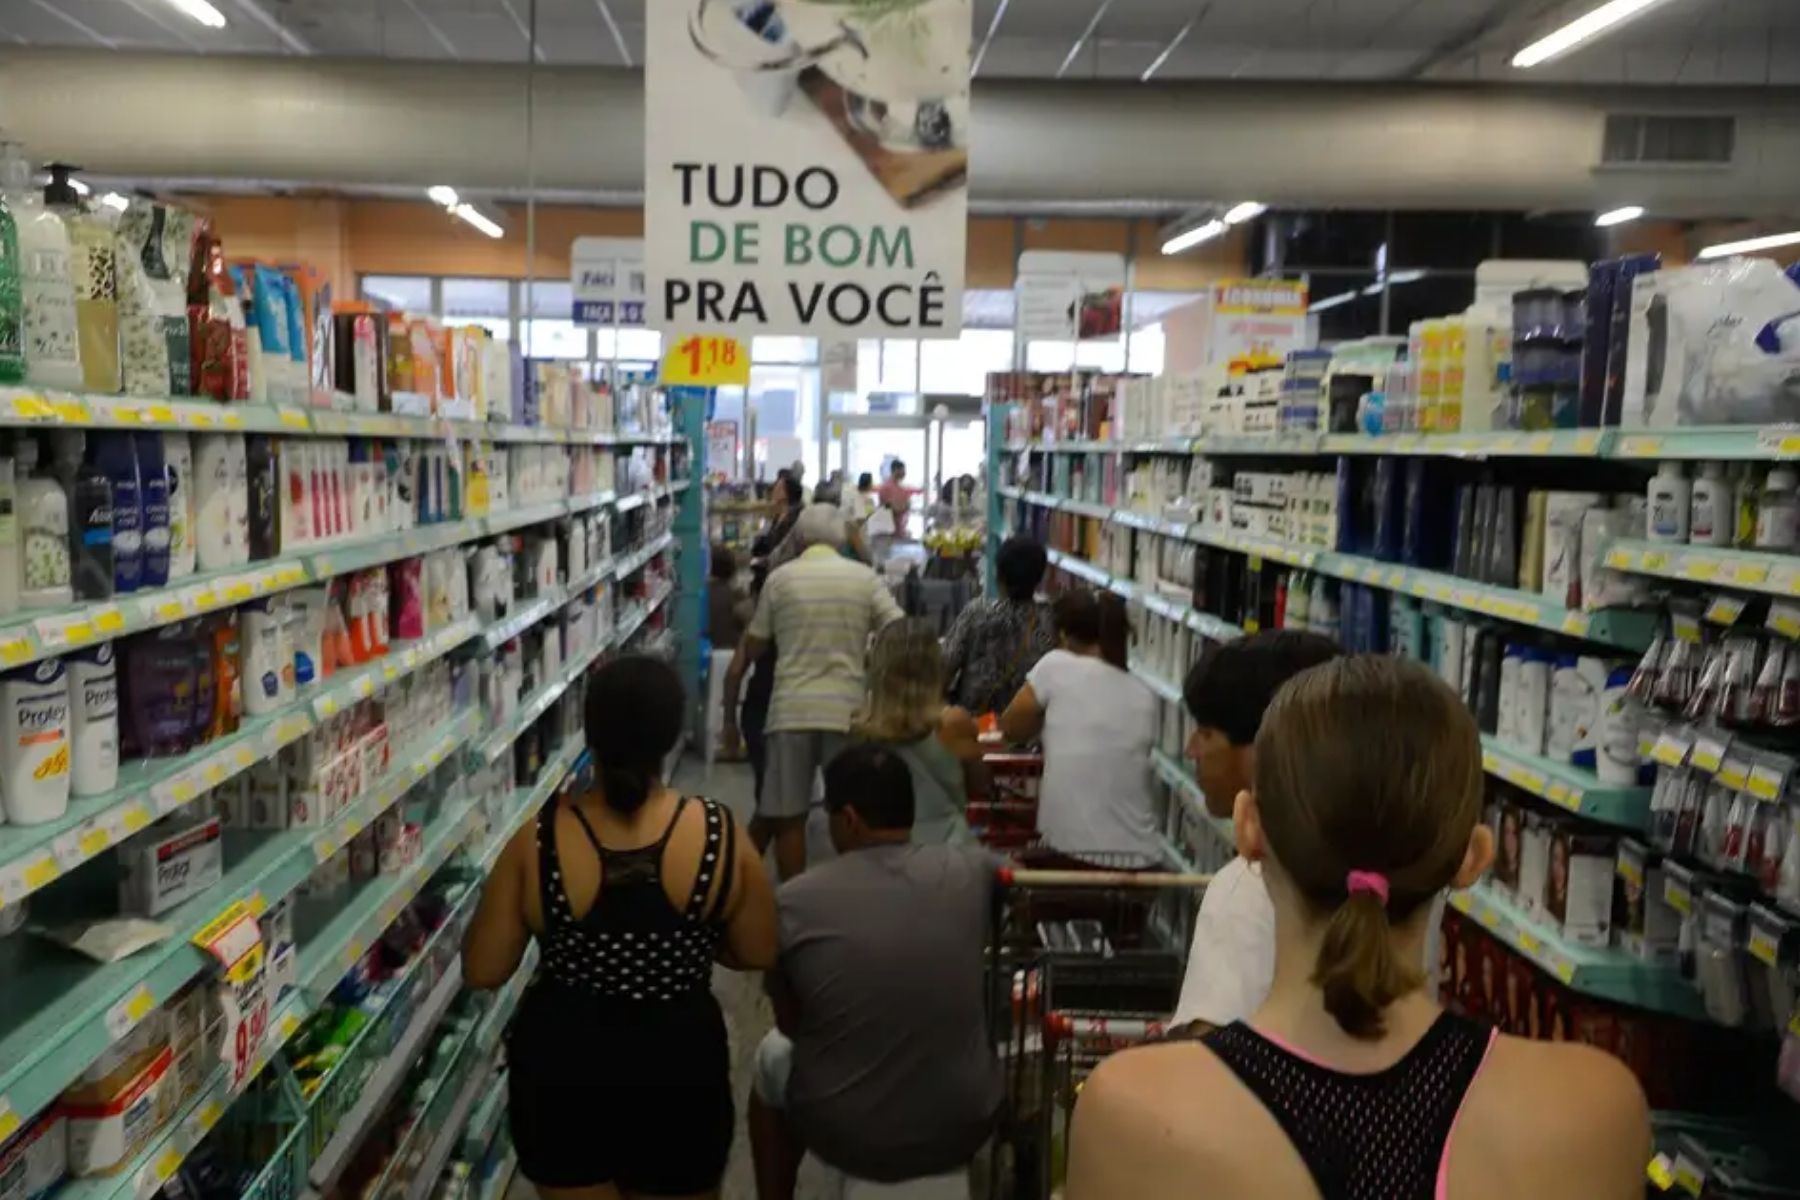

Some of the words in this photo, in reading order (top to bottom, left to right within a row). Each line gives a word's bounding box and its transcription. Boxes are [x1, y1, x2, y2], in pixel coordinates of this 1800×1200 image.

[672, 163, 838, 209] TUDO
[689, 221, 759, 265] DE
[784, 223, 915, 269] BOM
[664, 278, 768, 323] PRA
[788, 271, 944, 328] VOCÊ
[681, 334, 736, 376] 1,18
